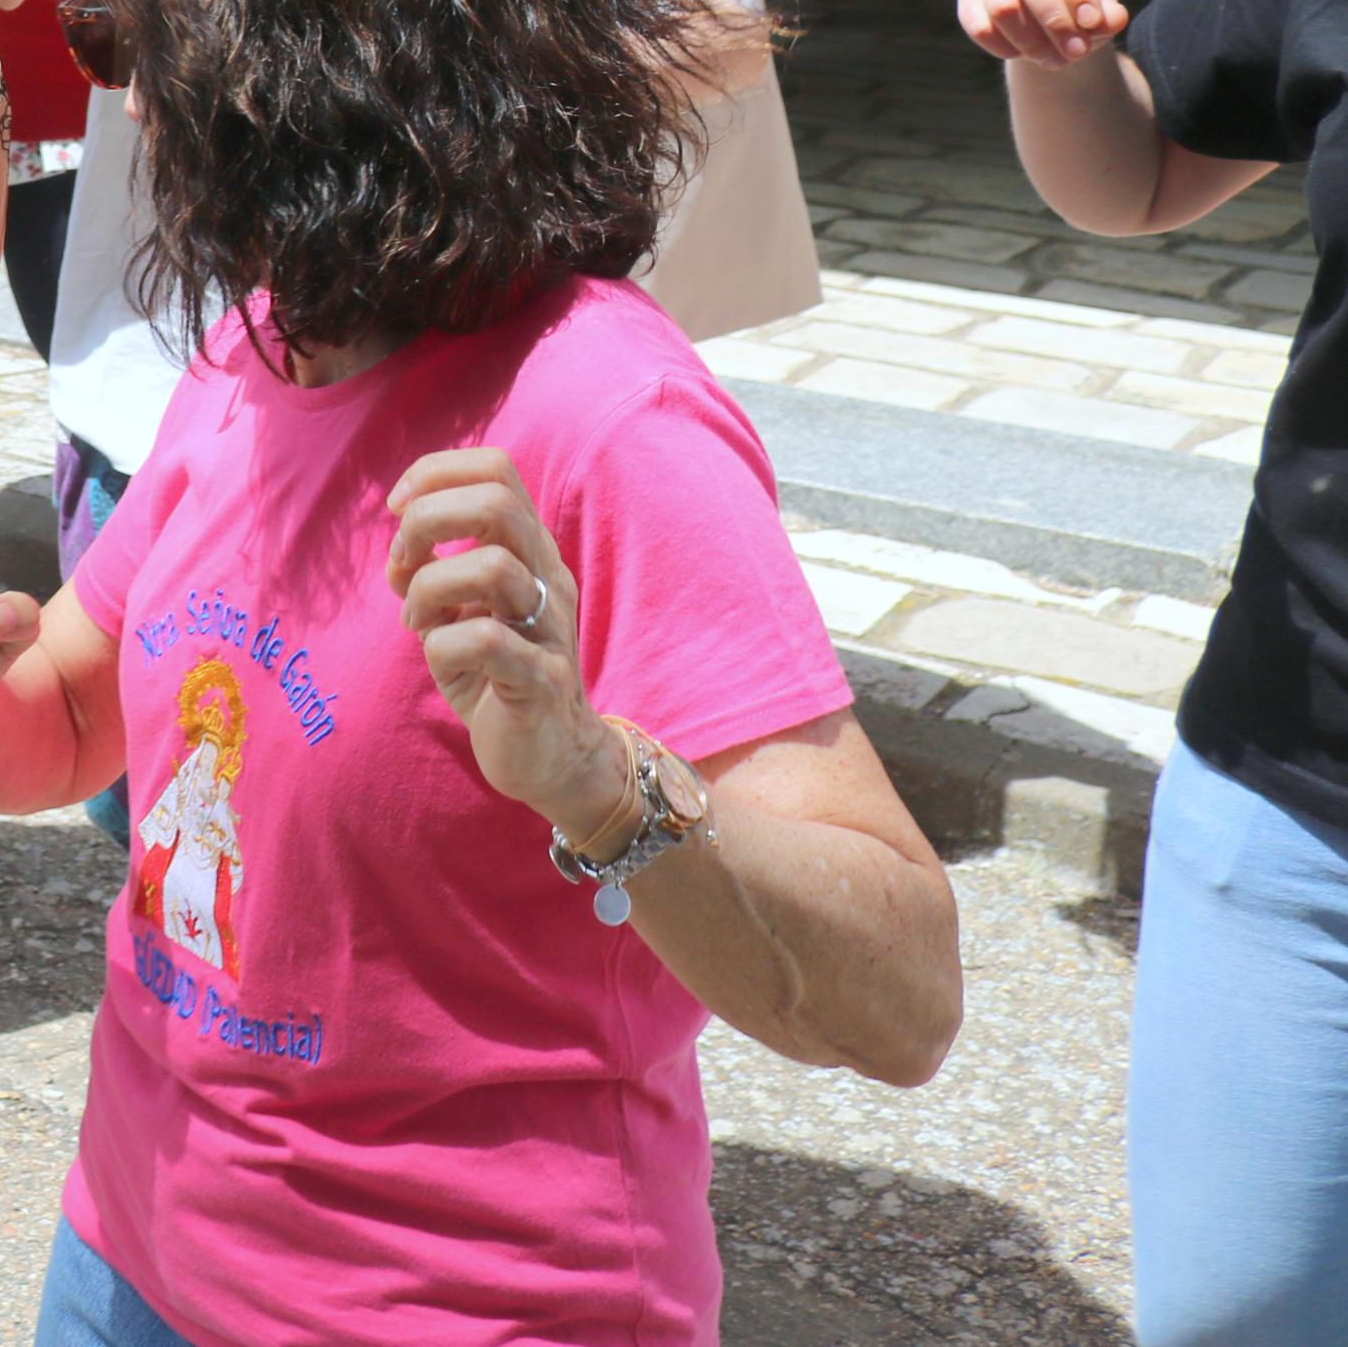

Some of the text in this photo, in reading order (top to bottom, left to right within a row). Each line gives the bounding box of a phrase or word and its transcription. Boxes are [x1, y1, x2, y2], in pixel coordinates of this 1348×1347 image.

[250, 617, 283, 669] de
[280, 648, 338, 747] Garón
[199, 984, 323, 1067] (Palencia)
